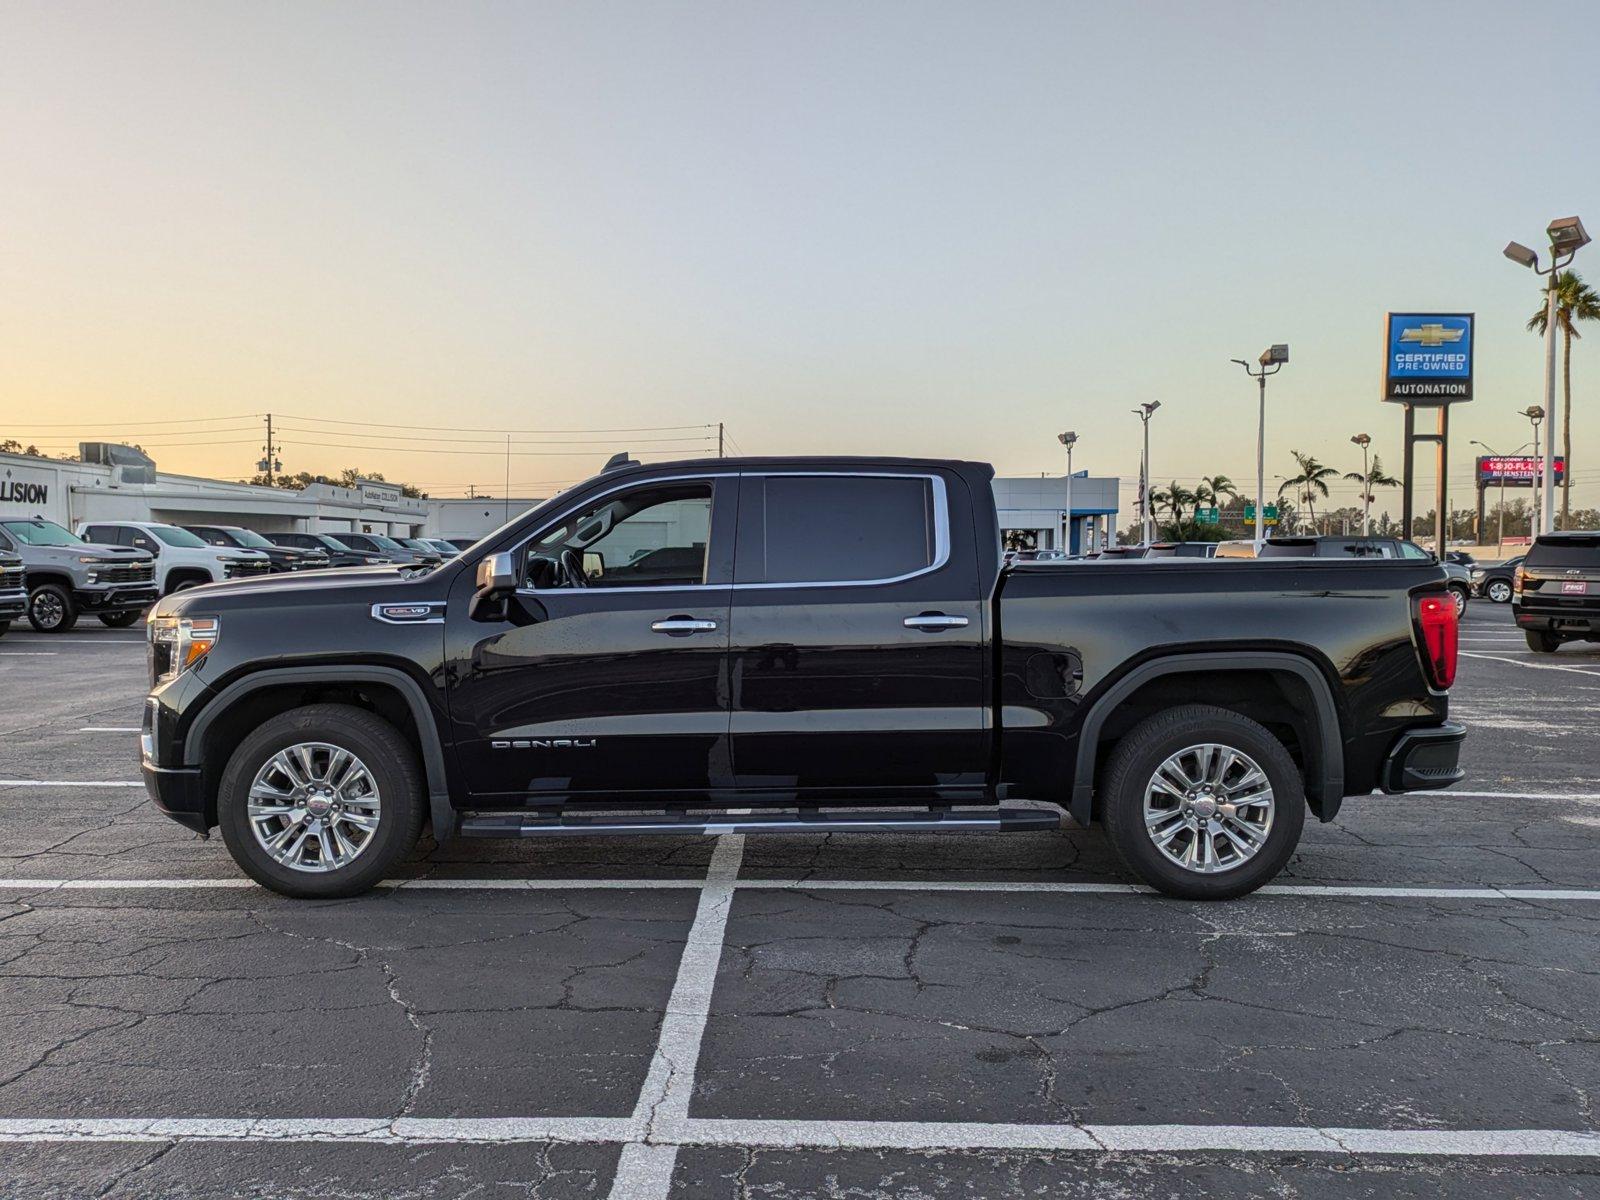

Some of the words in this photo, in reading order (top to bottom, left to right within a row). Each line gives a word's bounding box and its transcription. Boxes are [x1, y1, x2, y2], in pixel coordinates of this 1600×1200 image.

[1395, 353, 1466, 362] CERTIFIED
[1397, 362, 1464, 370] PRE-OWNED
[1394, 384, 1466, 394] AUTONATION
[0, 481, 48, 504] LISION
[492, 740, 596, 748] DENALI
